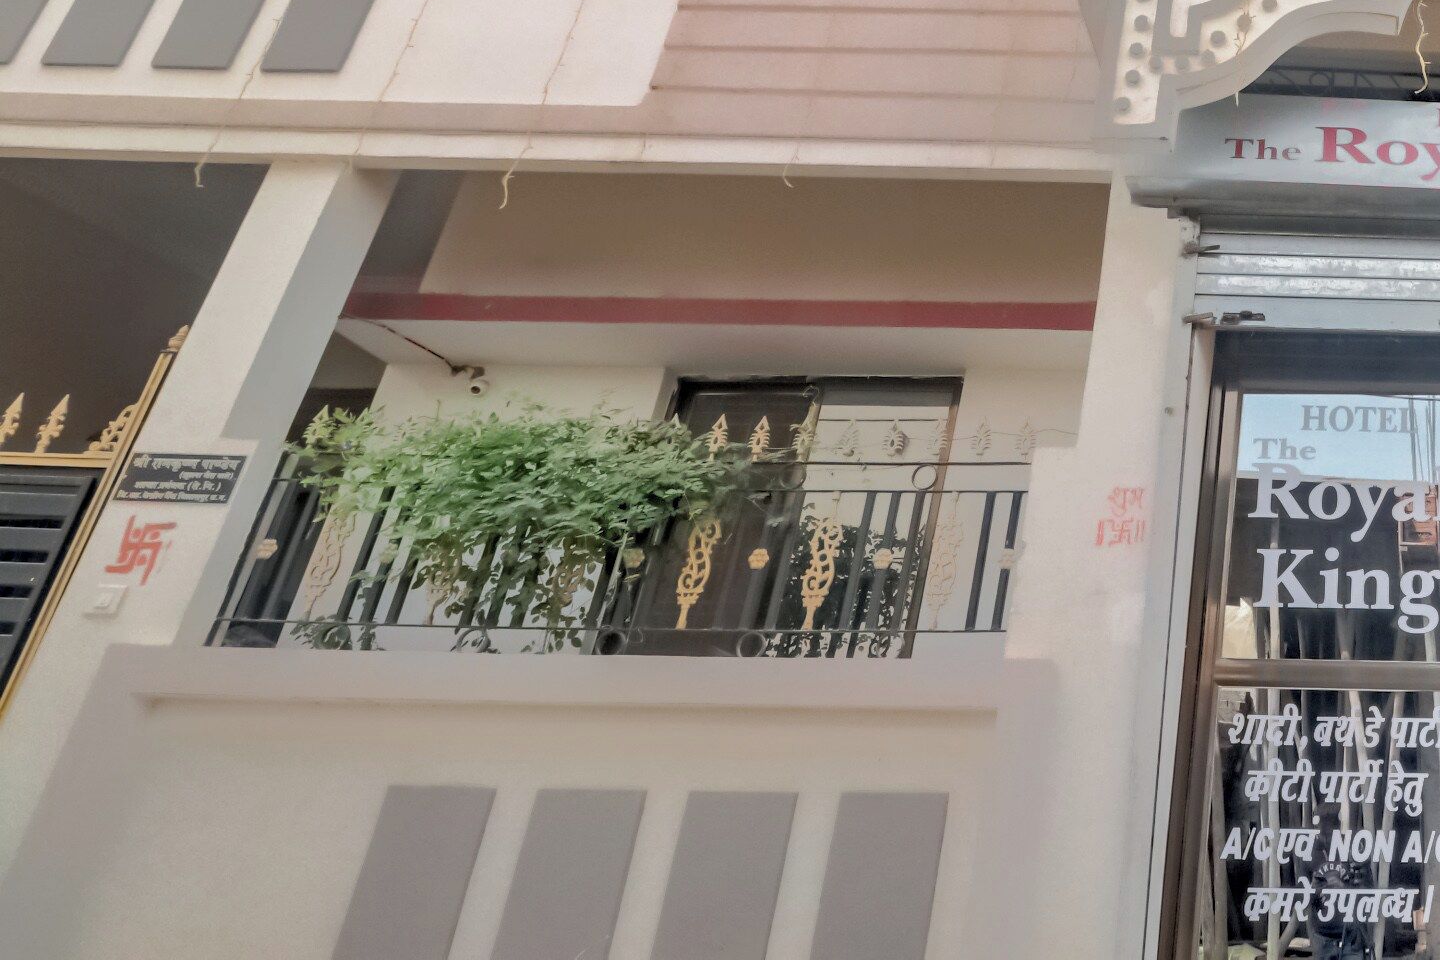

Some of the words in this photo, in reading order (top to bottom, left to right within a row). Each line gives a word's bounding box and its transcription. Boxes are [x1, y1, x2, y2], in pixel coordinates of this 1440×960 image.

[1224, 138, 1301, 162] The
[1301, 405, 1417, 434] HOTEL
[1253, 438, 1317, 460] The
[1228, 703, 1308, 751] शादी,
[1384, 760, 1429, 817] हेतु
[1329, 829, 1396, 863] NON
[1244, 876, 1316, 922] कमरे
